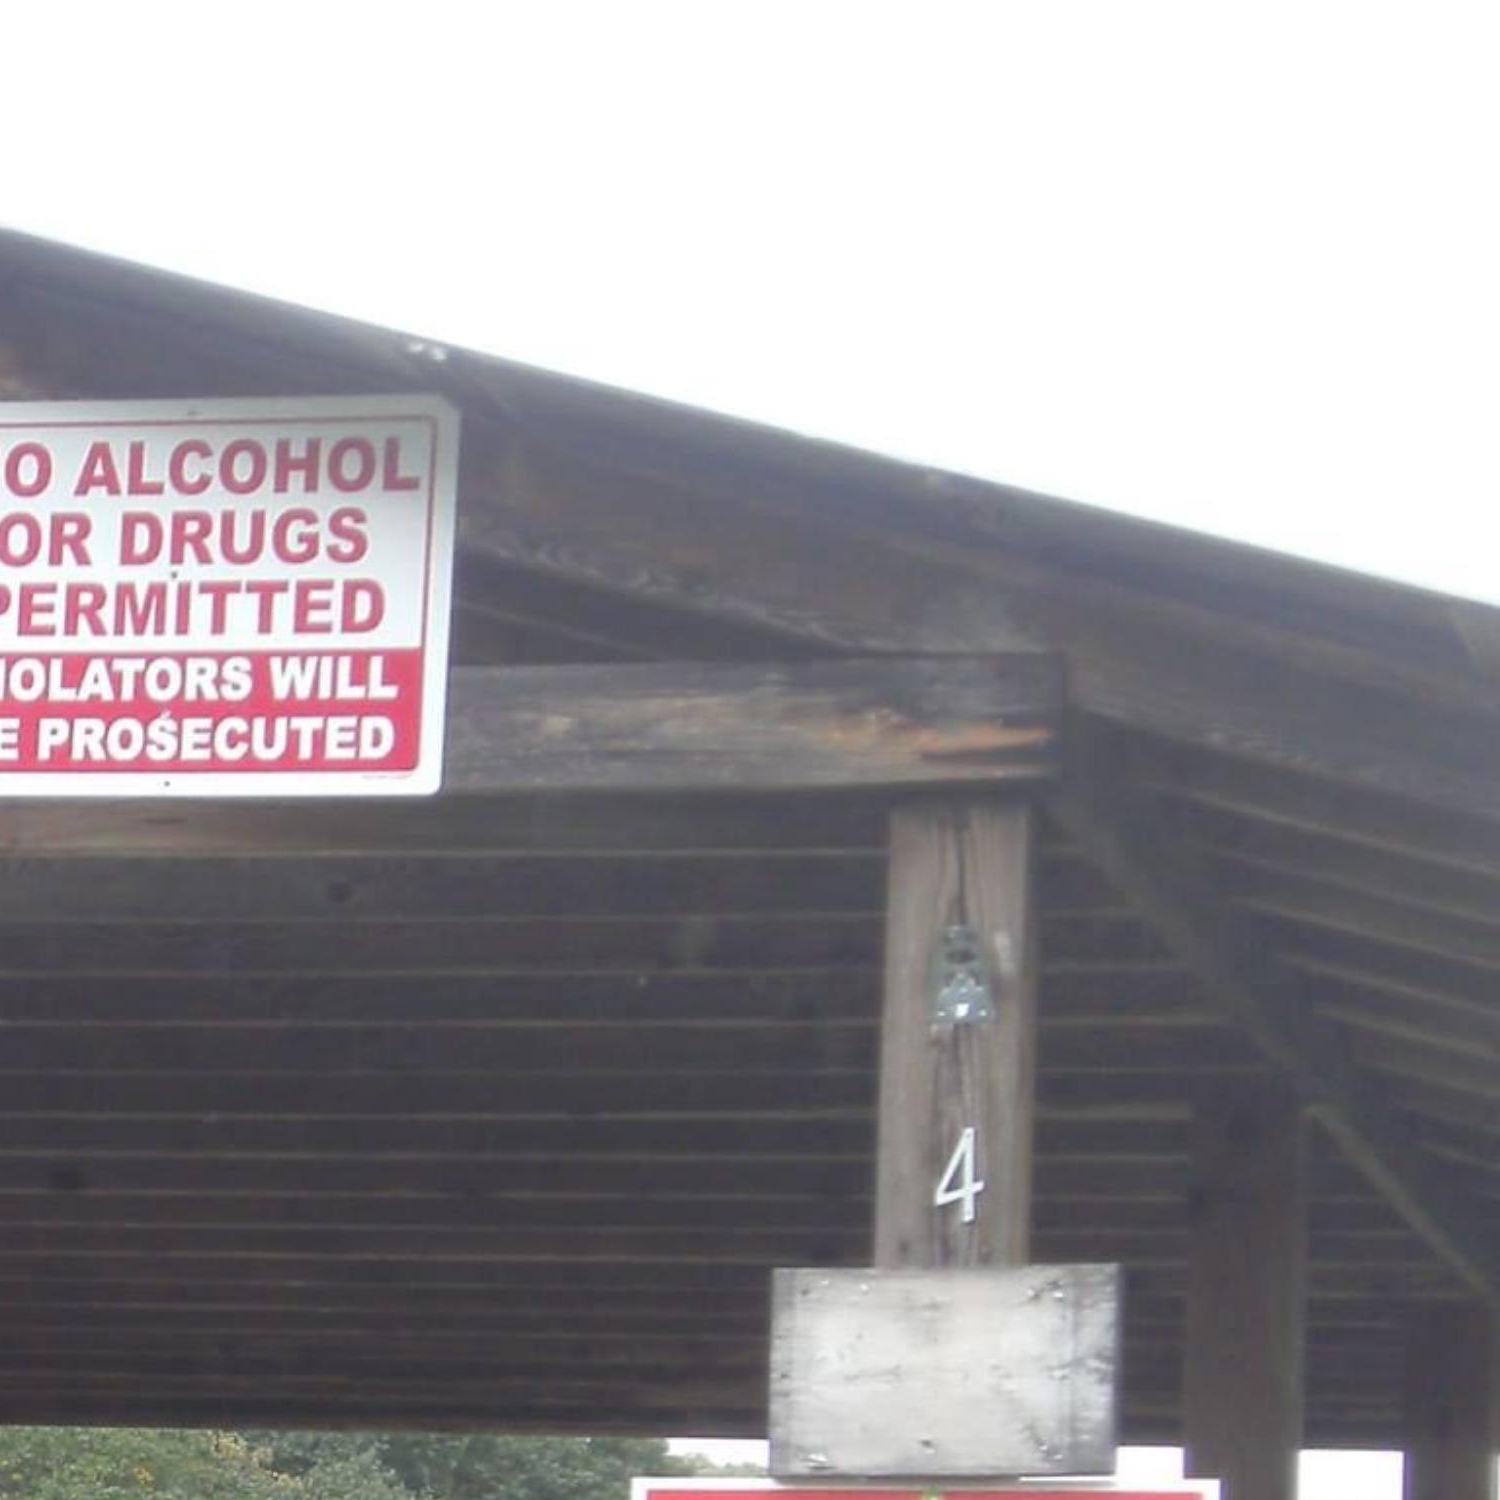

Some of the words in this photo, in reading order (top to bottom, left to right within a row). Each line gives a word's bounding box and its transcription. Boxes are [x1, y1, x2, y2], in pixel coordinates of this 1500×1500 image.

[73, 436, 421, 497] ALCOHOL
[119, 506, 369, 566] DRUGS
[268, 656, 399, 700] WILL
[37, 715, 396, 761] PROSECUTED
[933, 1126, 985, 1224] 4
